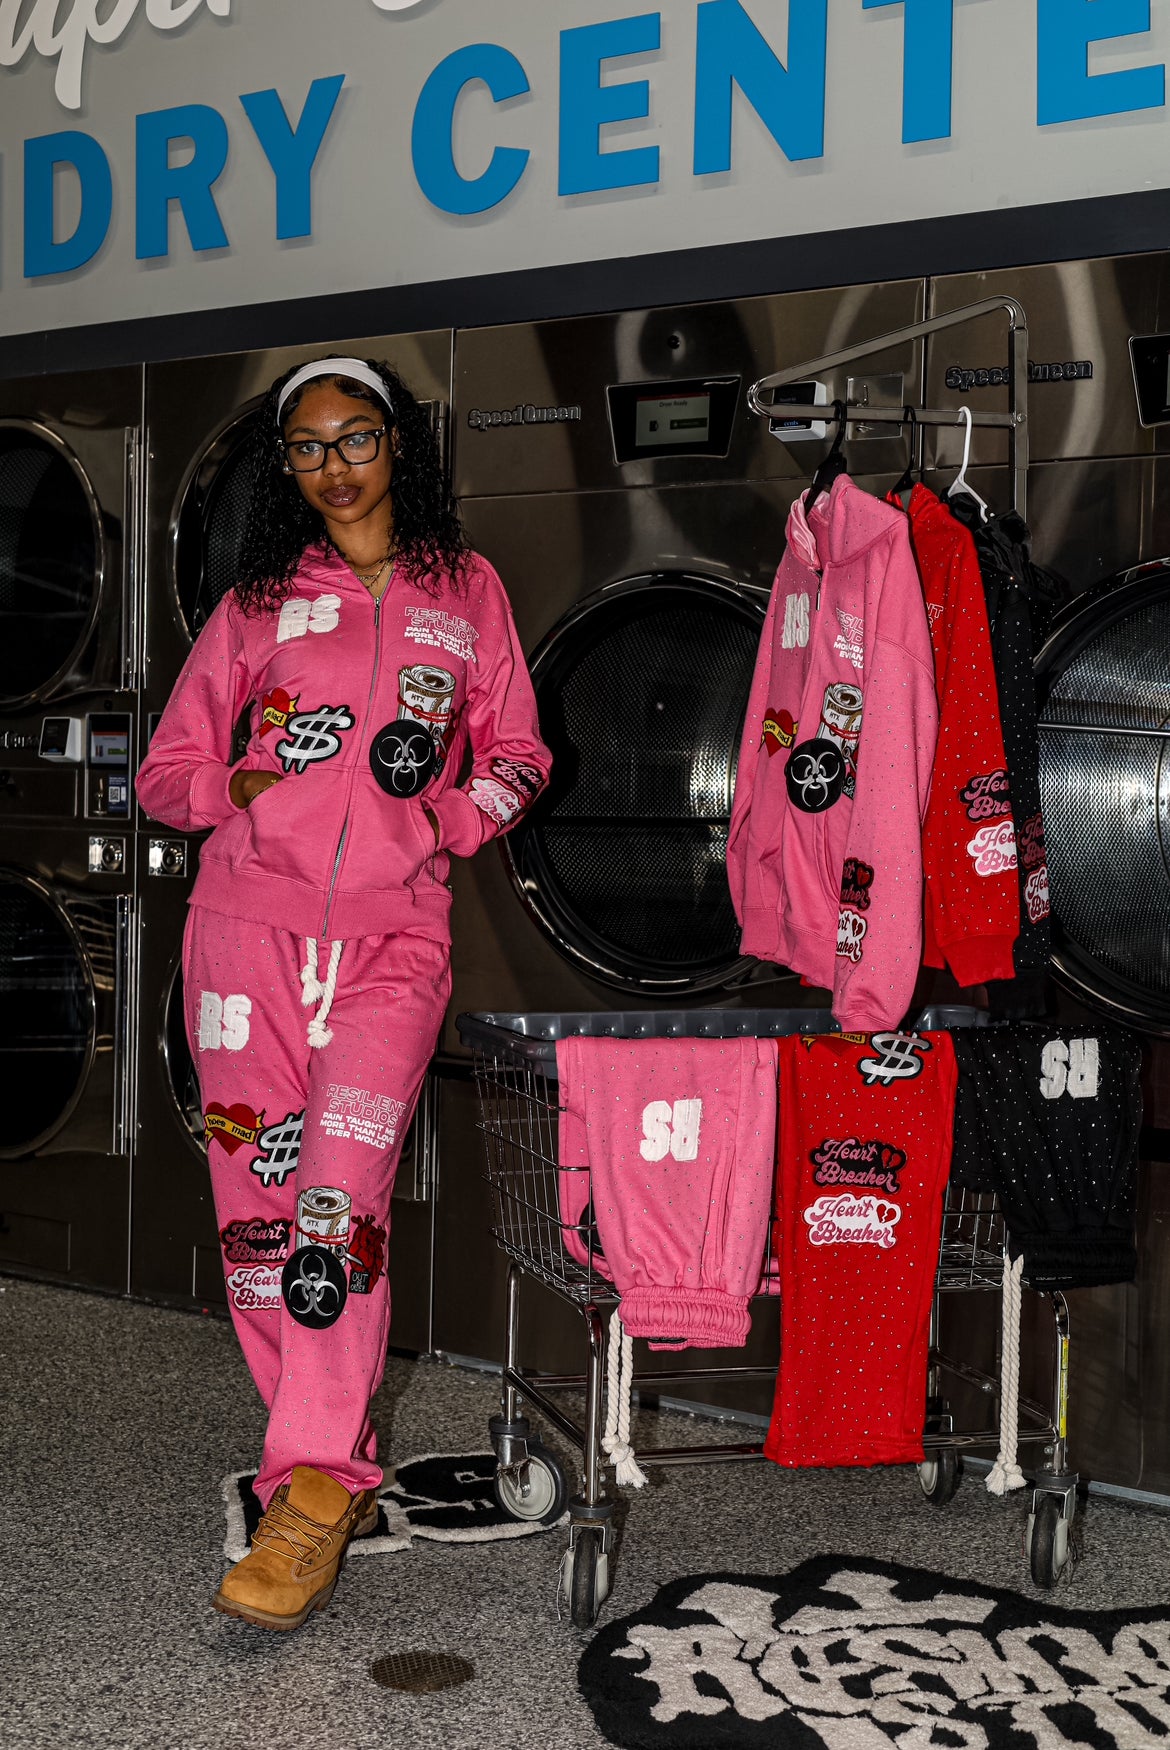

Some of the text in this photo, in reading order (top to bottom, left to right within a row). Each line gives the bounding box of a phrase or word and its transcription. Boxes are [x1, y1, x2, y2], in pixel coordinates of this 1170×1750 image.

[24, 0, 1165, 279] DRY CENTE
[468, 403, 582, 431] Speed Queen
[404, 632, 434, 640] MORE
[436, 635, 460, 650] THAN
[406, 626, 466, 646] PAIN TAUGHT
[411, 616, 474, 646] STUDIO
[415, 638, 440, 648] EVER
[326, 1084, 407, 1116] RESILIENT
[322, 1112, 396, 1137] PAIN TAUGHT ME
[328, 1098, 398, 1128] STUDIOS
[206, 1116, 253, 1139] hoes mad
[320, 1119, 395, 1144] MORE THAN LOVE
[325, 1128, 386, 1149] EVER WOULD
[815, 1139, 878, 1163] Heart
[815, 1161, 897, 1192] Breaker
[810, 1197, 874, 1222] Heart
[225, 1221, 286, 1242] Heart
[811, 1220, 894, 1248] Breaker
[352, 1272, 368, 1282] OUT
